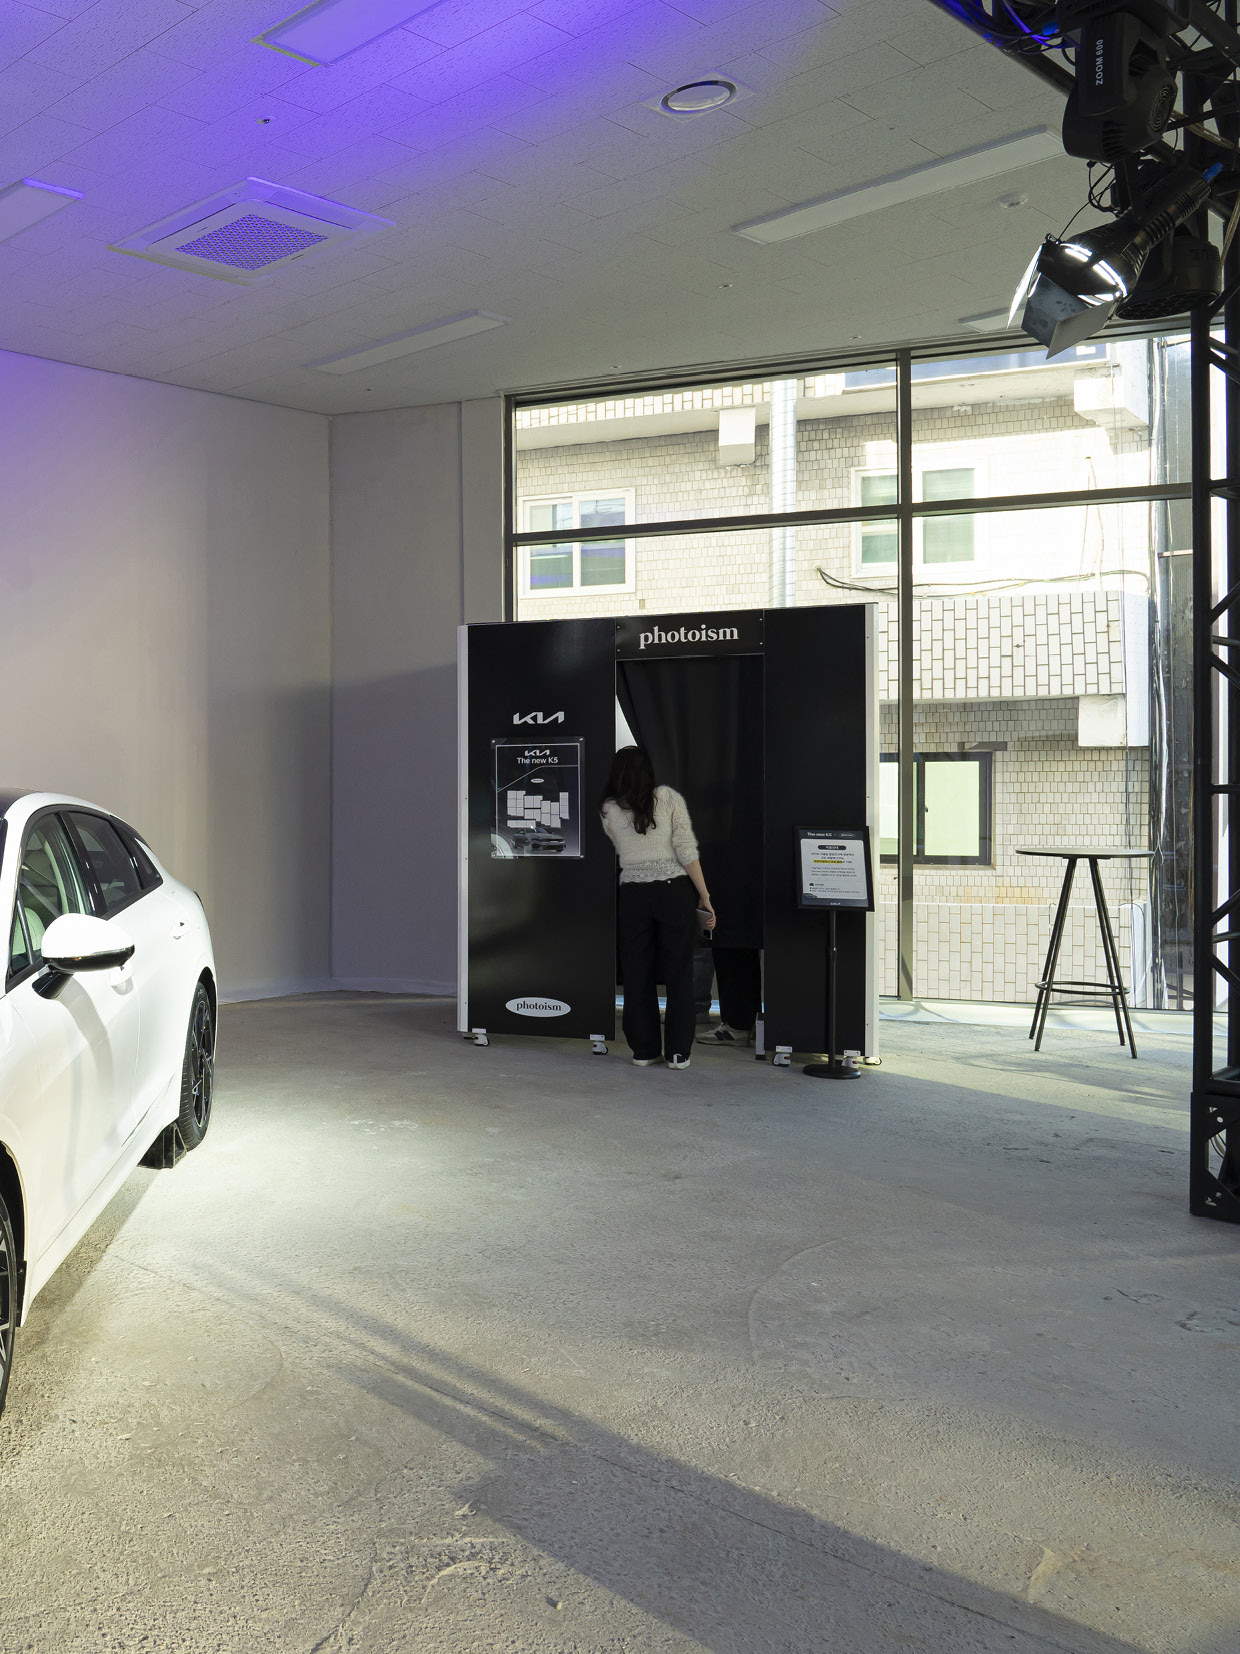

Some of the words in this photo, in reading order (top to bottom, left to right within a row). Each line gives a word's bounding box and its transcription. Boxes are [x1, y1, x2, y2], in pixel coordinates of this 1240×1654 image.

[1095, 39, 1104, 55] 600
[1095, 56, 1104, 86] ZOOM
[638, 624, 739, 650] photoism
[513, 711, 564, 724] KIA
[516, 1001, 561, 1011] photoism
